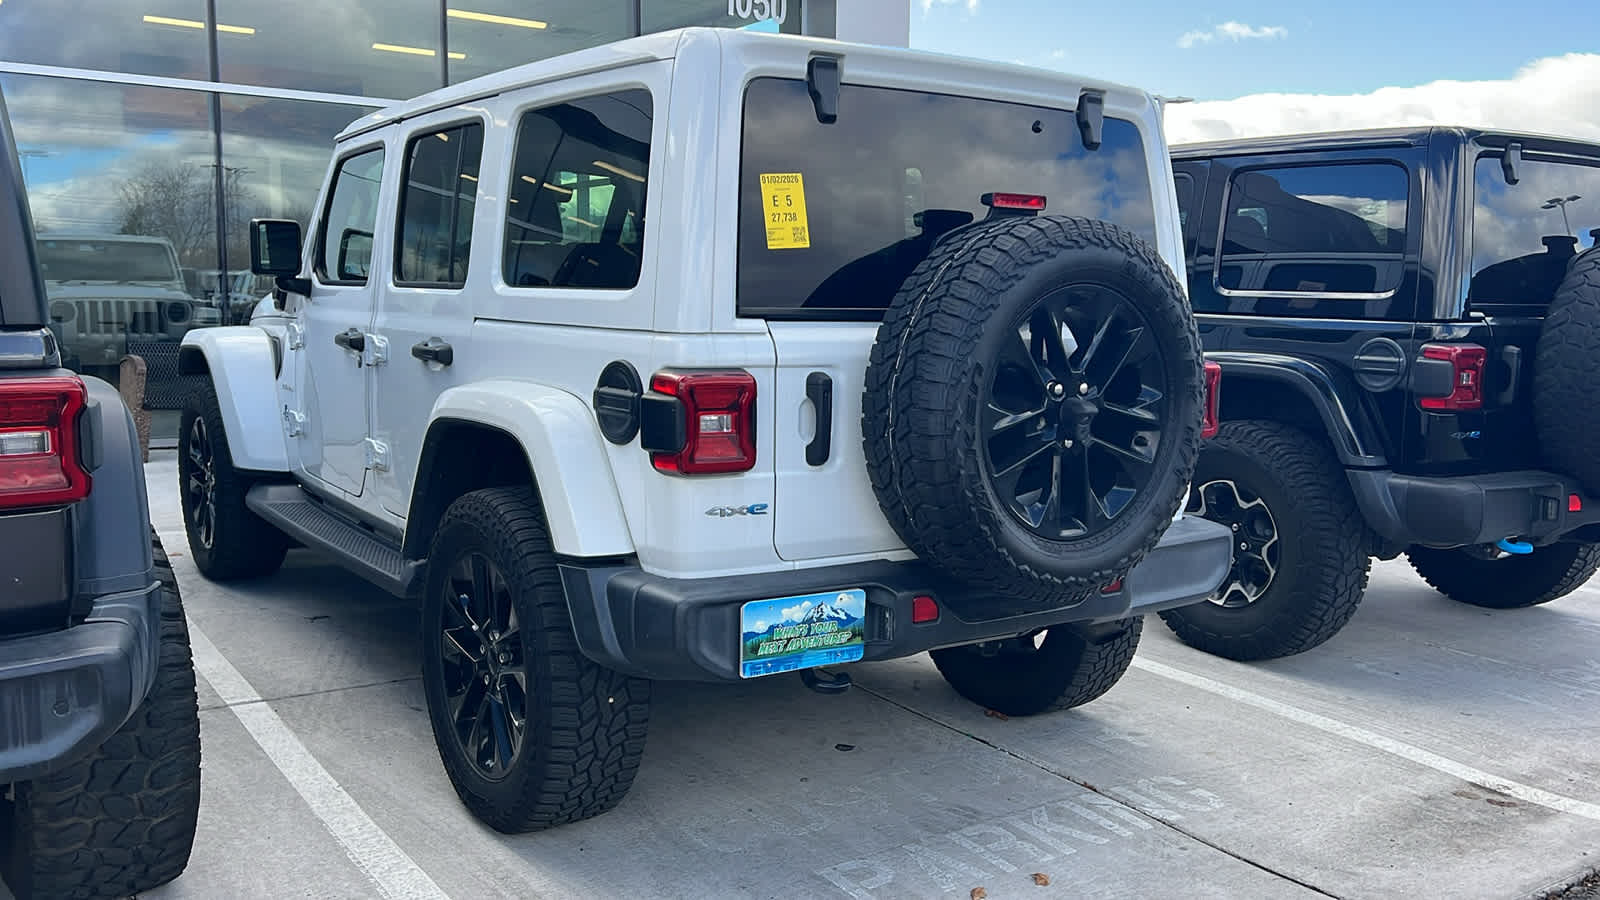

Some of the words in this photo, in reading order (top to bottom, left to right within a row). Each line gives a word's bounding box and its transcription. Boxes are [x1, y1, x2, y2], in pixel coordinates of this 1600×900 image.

[772, 194, 779, 207] E
[785, 194, 793, 207] 5
[771, 212, 798, 223] 27,738
[809, 620, 838, 638] YOUR
[757, 639, 788, 656] NEXT
[785, 631, 853, 652] ADVENTURE?
[816, 775, 1222, 899] PARKING
